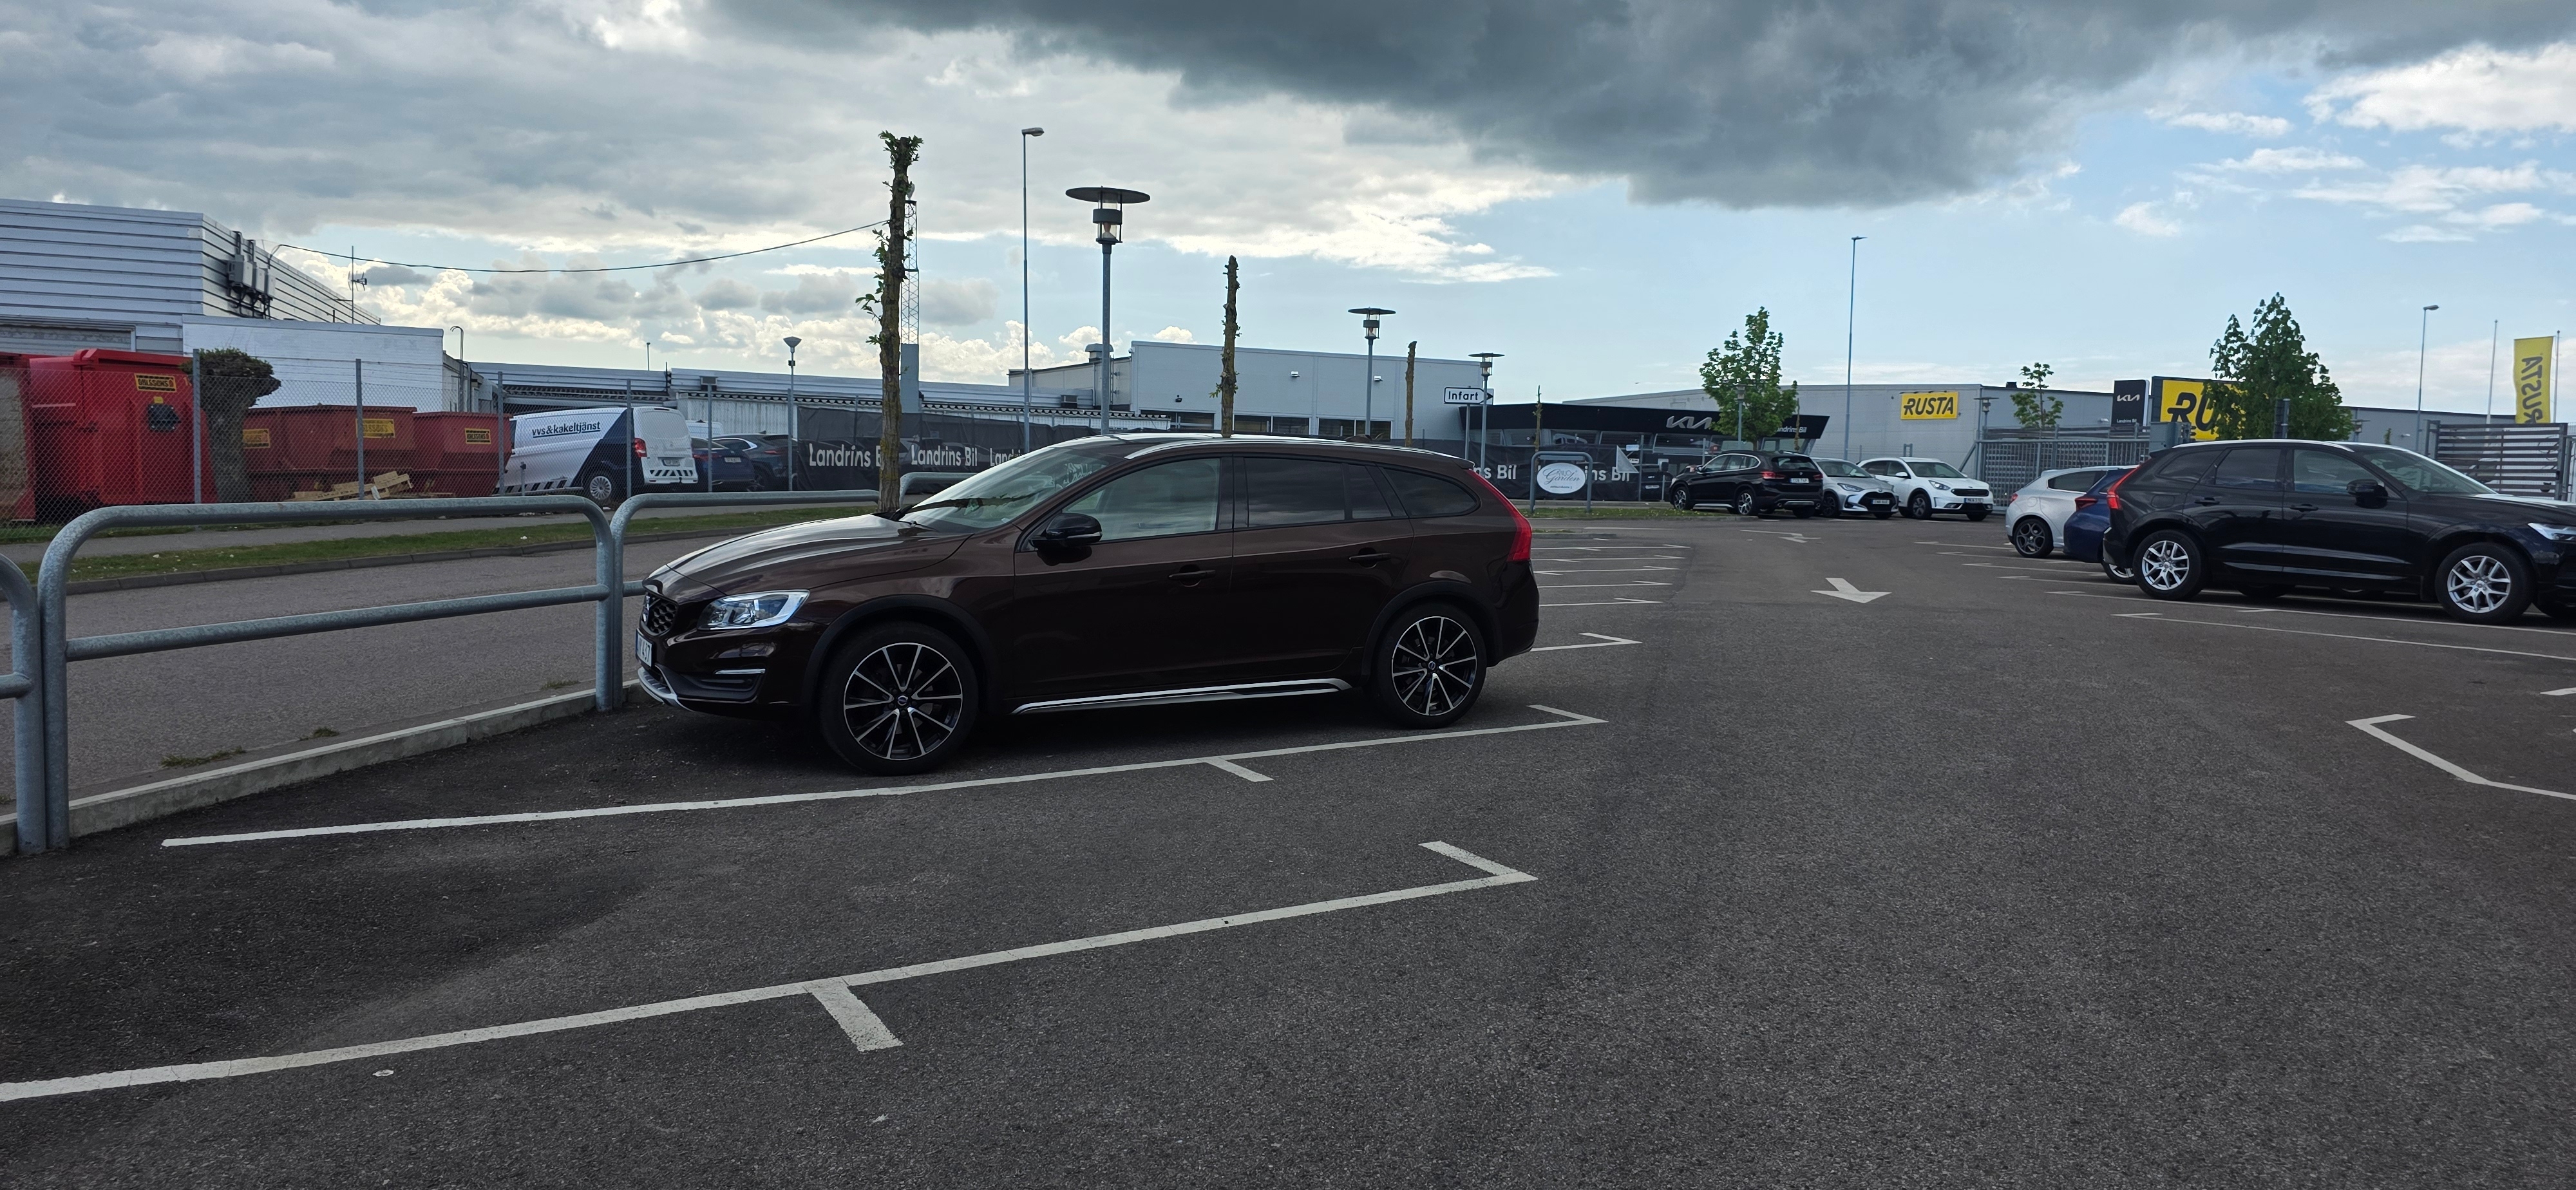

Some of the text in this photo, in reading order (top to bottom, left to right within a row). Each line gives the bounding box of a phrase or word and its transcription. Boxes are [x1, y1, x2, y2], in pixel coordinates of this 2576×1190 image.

[1448, 390, 1479, 401] Infart
[1903, 396, 1954, 415] RUSTA
[531, 421, 601, 437] vvs&kakeltjänst
[809, 443, 871, 468] Landrins
[911, 444, 978, 466] Landrins Bil
[1497, 464, 1517, 480] Bil
